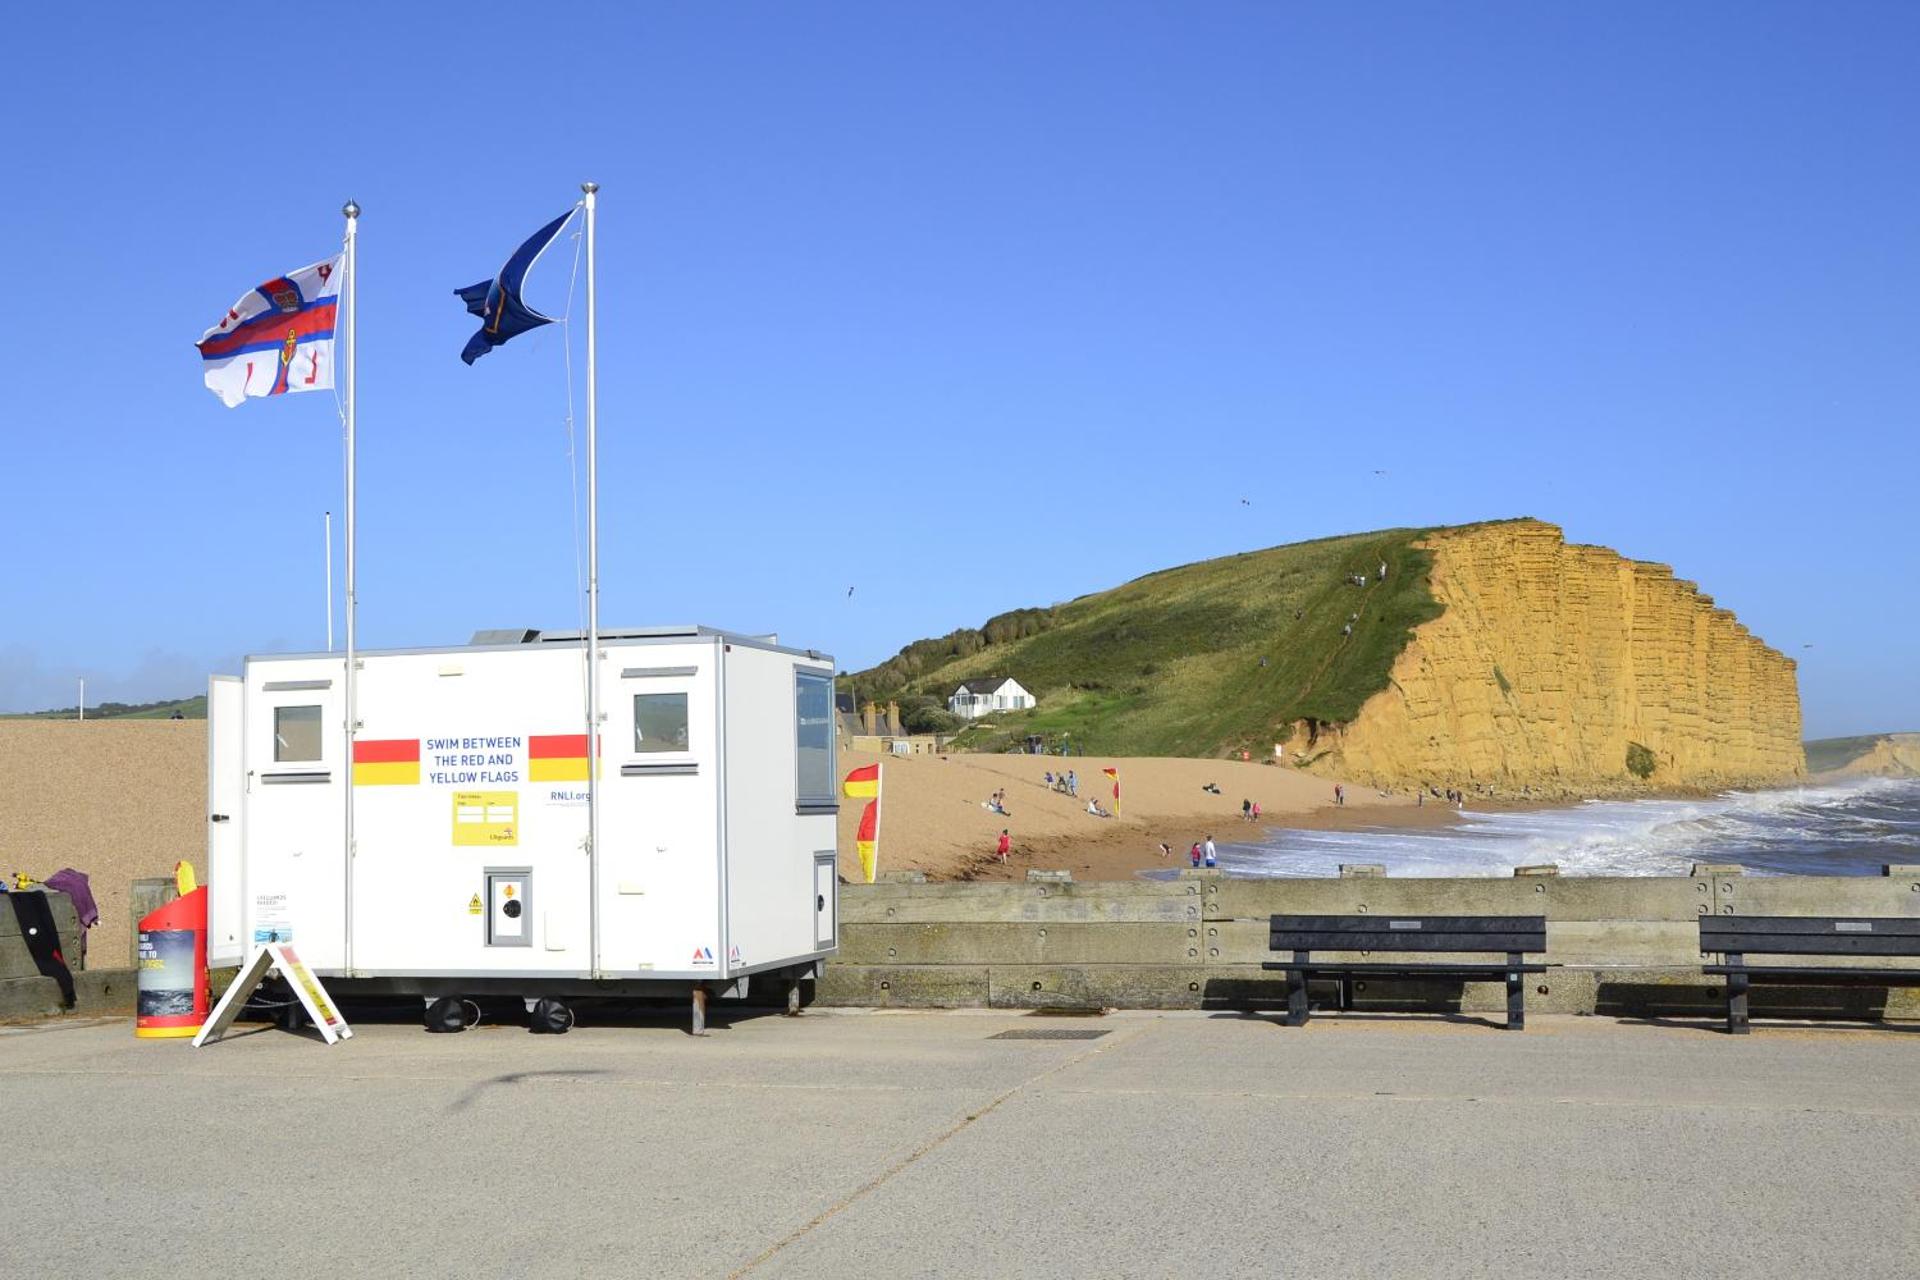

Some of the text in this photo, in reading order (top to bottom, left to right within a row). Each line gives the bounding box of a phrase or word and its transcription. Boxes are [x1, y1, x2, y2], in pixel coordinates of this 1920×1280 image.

[426, 736, 521, 750] SWIM BETWEEN
[434, 753, 513, 767] THE RED AND
[429, 770, 519, 784] YELLOW FLAGS
